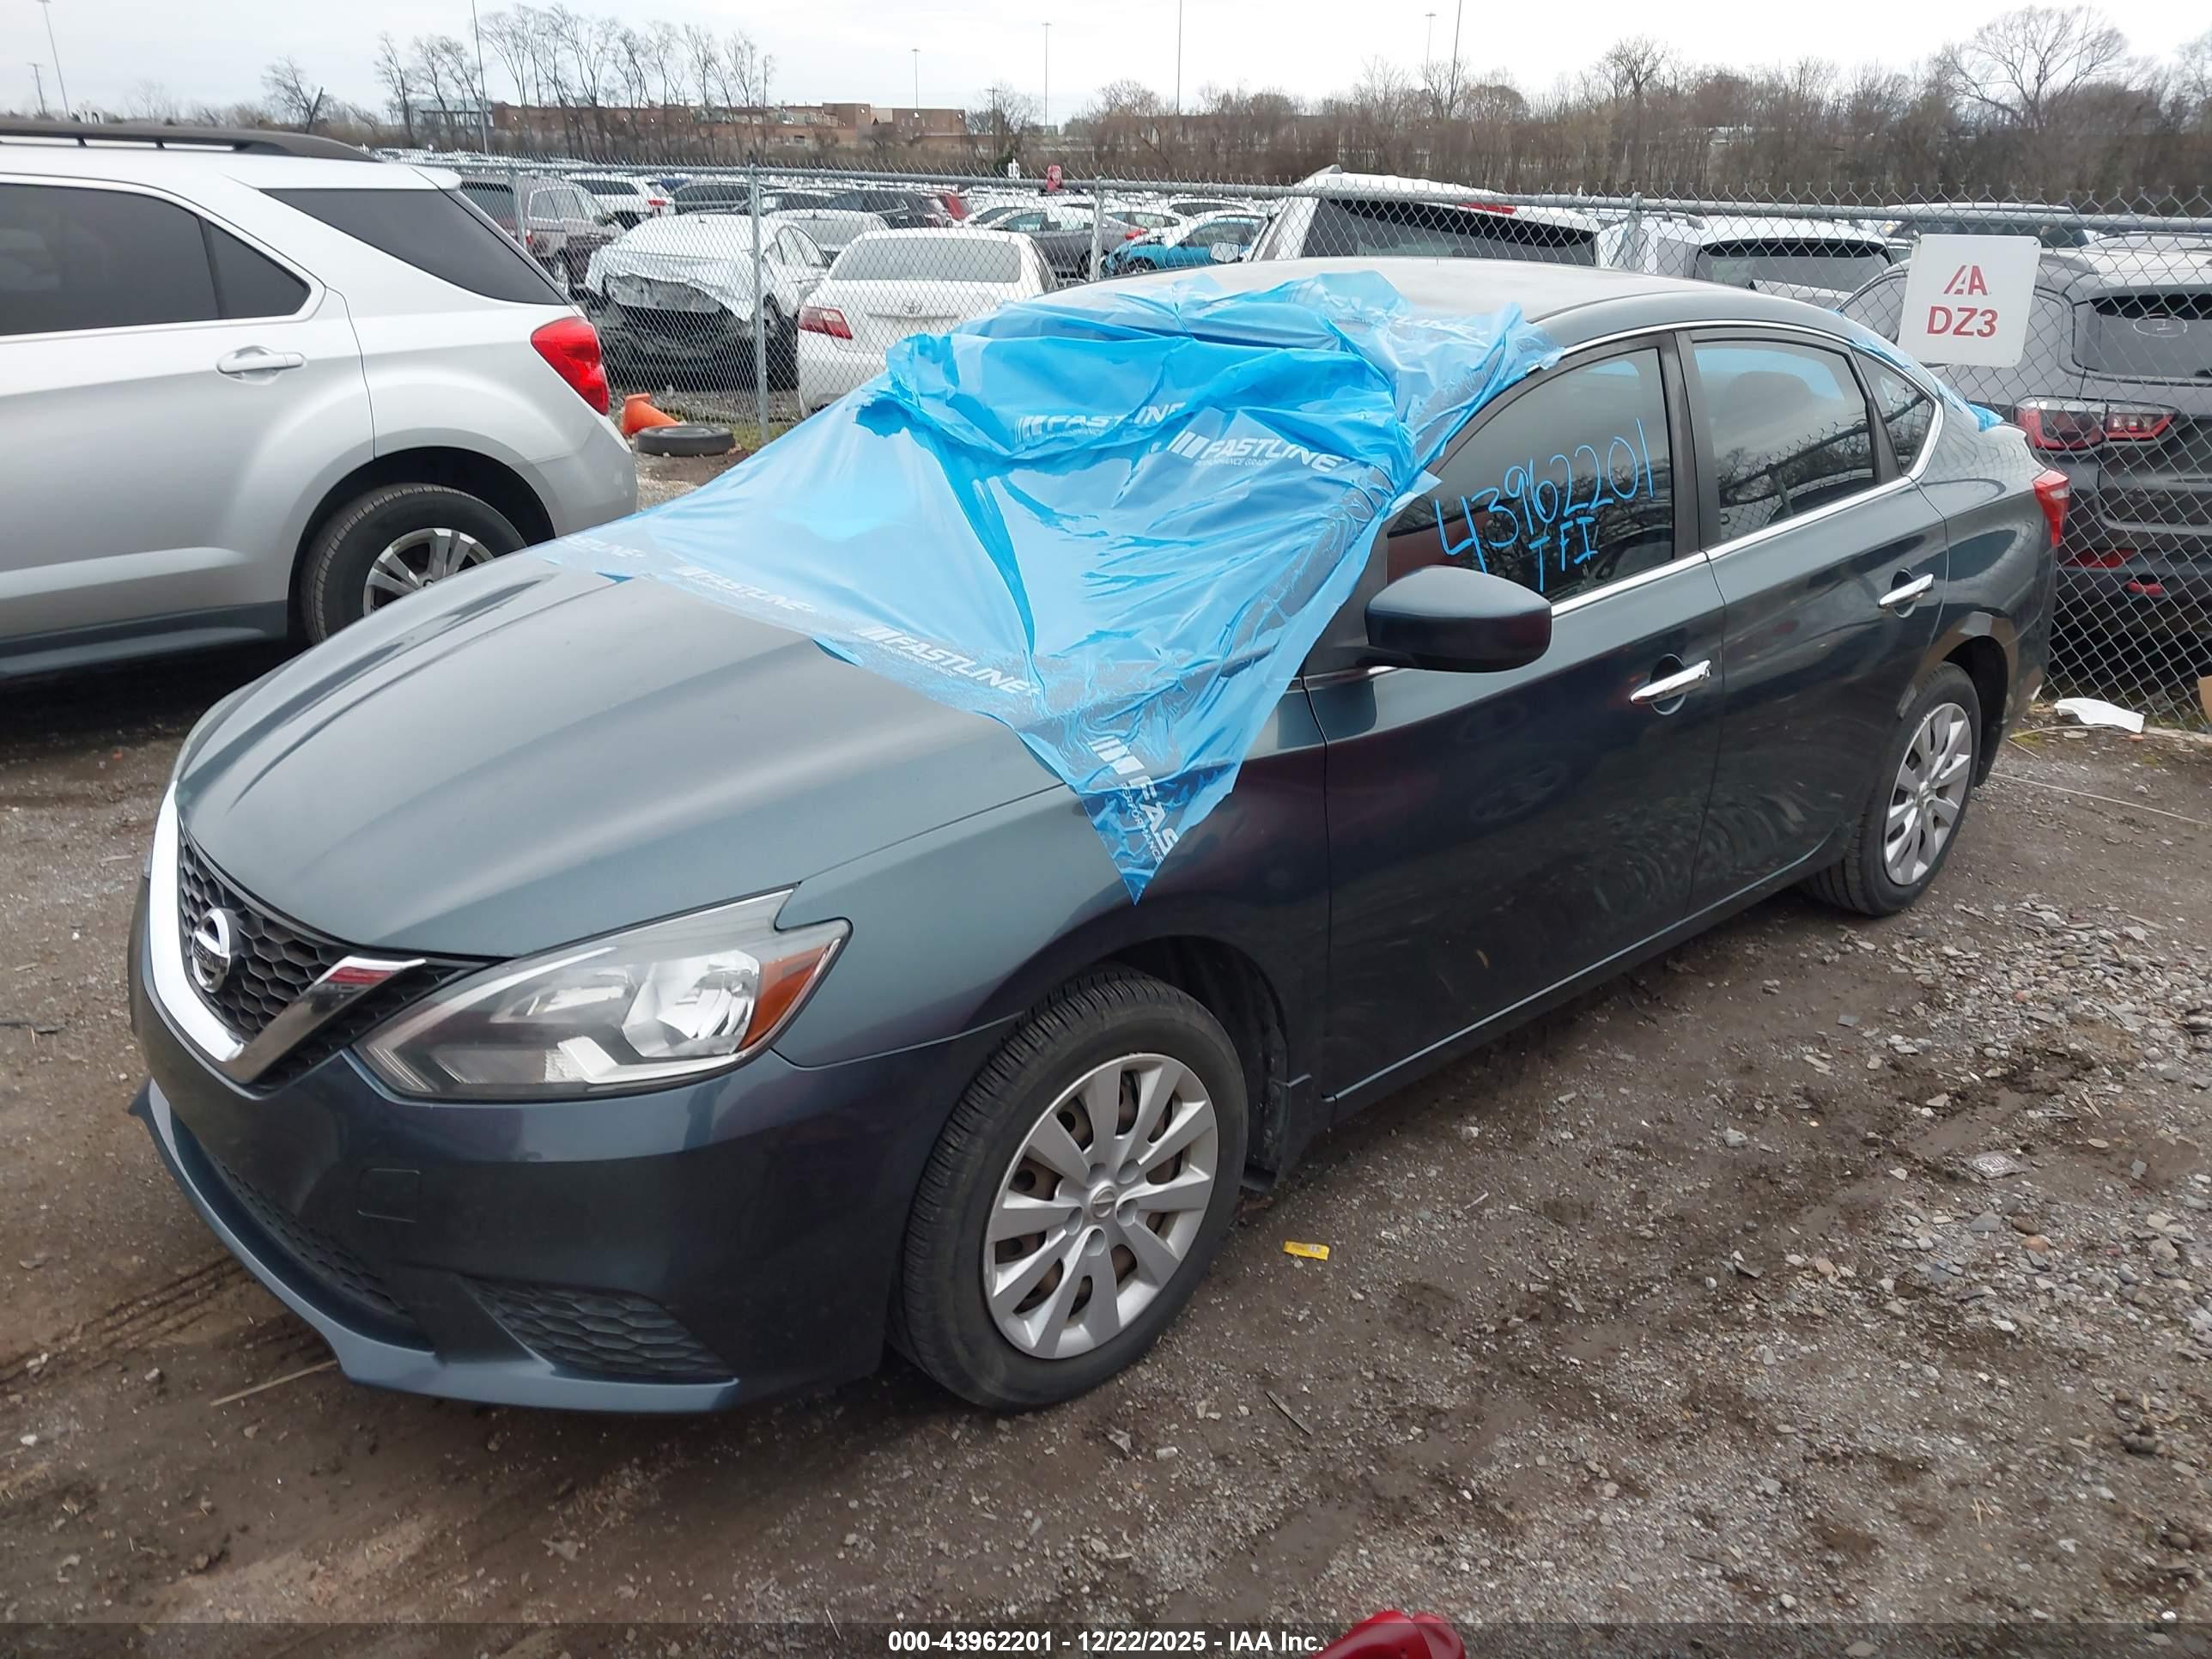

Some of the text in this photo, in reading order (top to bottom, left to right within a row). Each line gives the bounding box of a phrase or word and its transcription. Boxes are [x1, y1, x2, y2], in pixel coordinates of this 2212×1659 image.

[1927, 306, 1998, 337] DZ3
[1200, 438, 1342, 472] FASTLINE
[1435, 417, 1655, 574] 43962201
[1528, 516, 1599, 592] TFI
[884, 635, 1035, 694] FASTLINE
